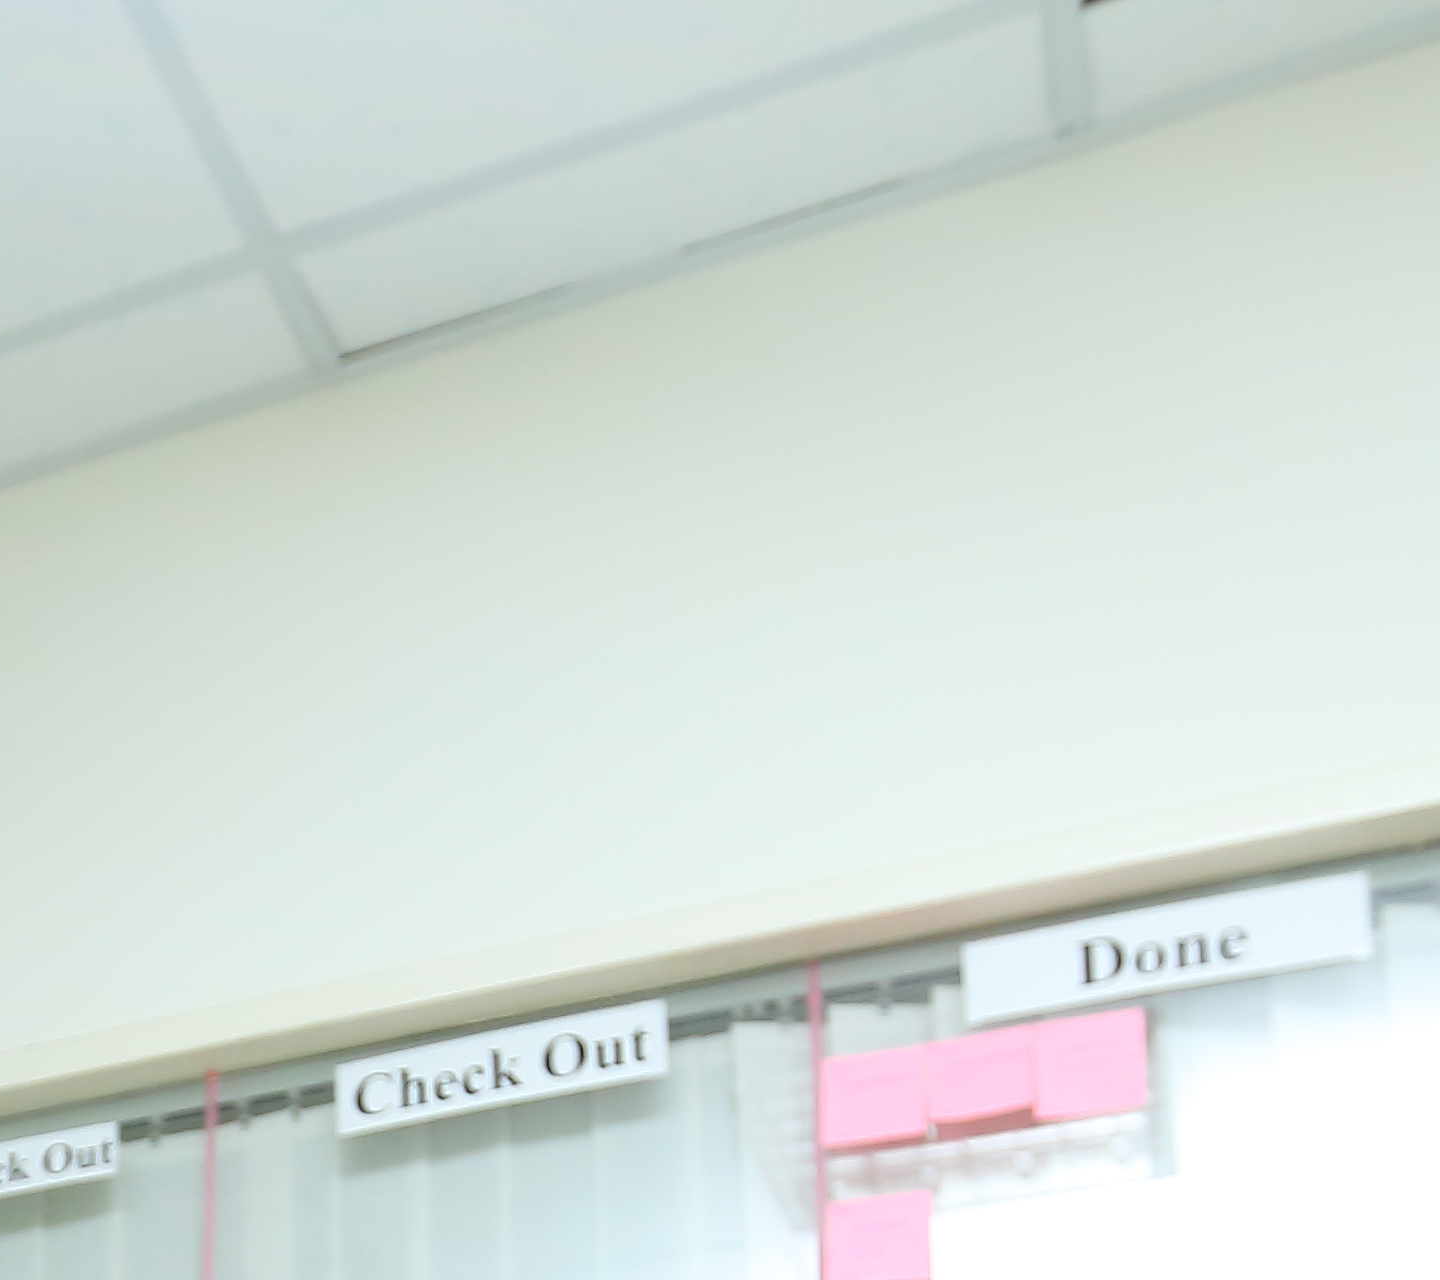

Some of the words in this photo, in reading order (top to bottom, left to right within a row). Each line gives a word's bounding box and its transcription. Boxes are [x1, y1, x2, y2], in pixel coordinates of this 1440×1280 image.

[1078, 924, 1249, 986] Done
[355, 1047, 525, 1115] Check
[544, 1025, 651, 1077] Out
[43, 1139, 115, 1174] Out
